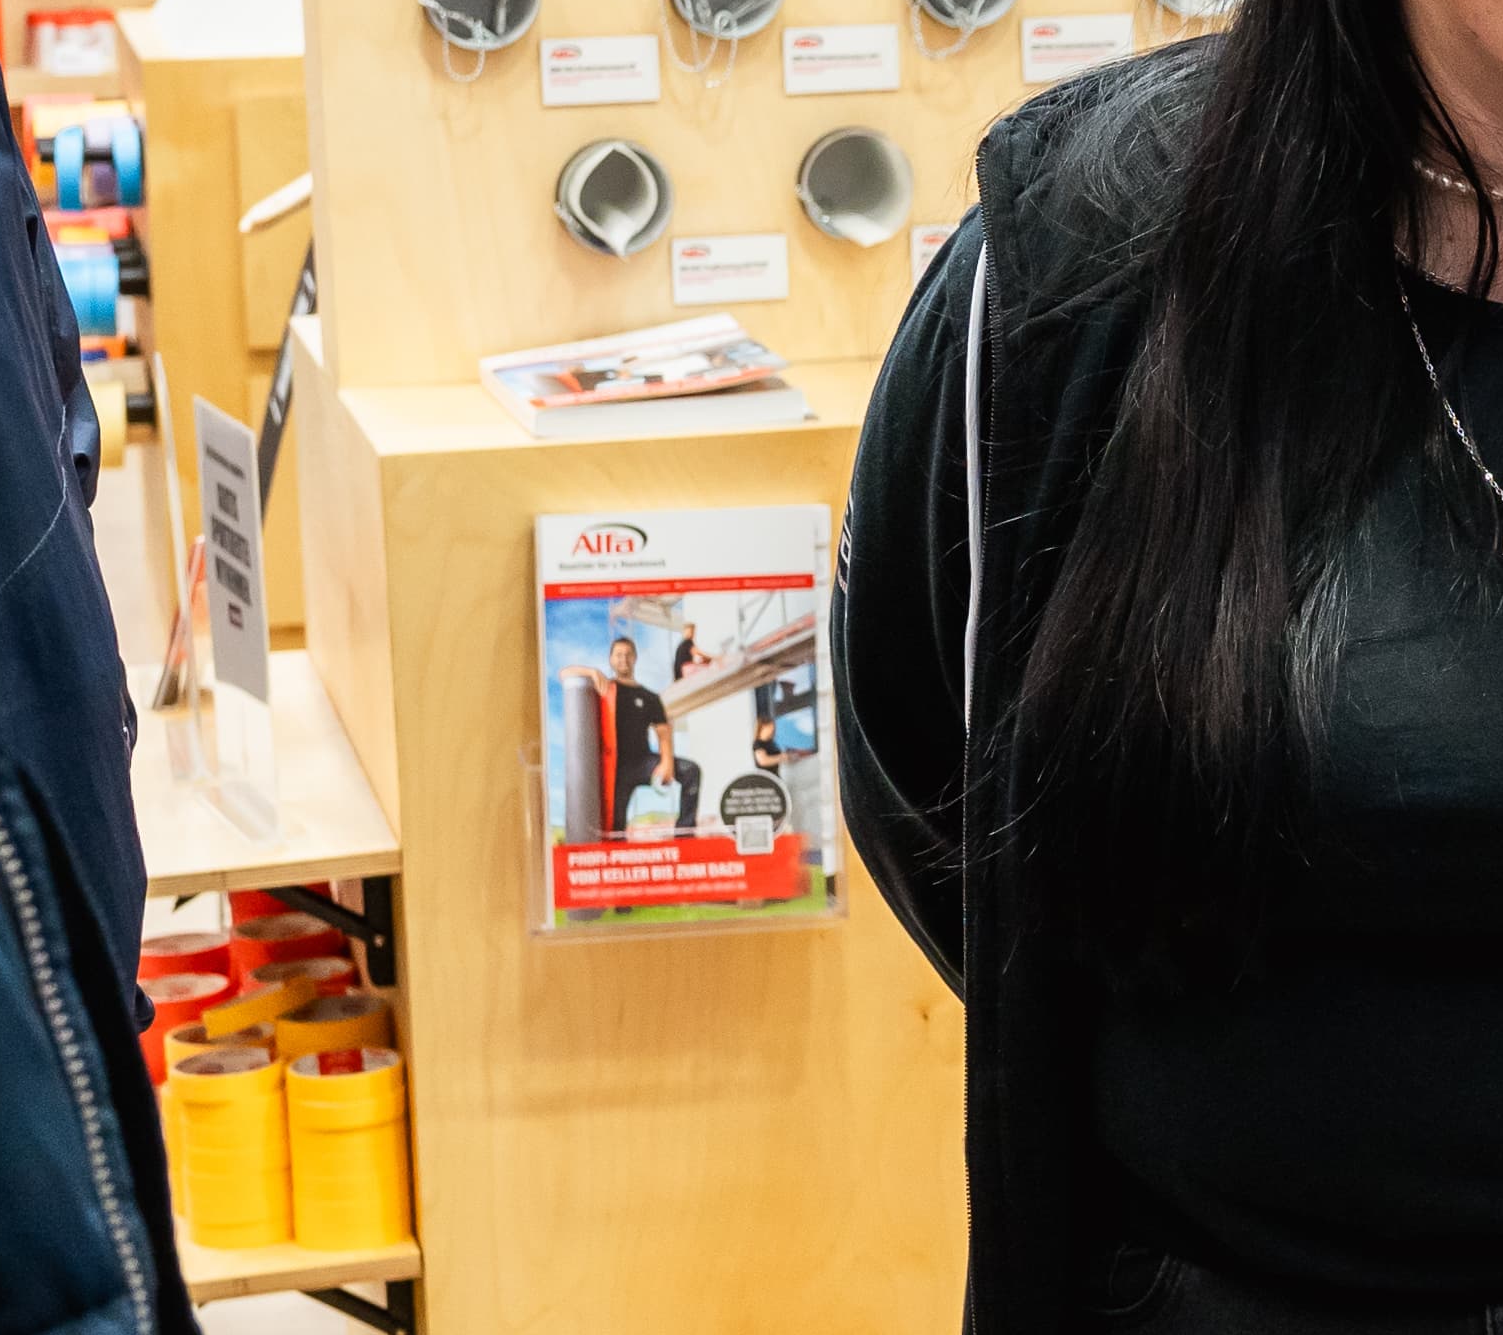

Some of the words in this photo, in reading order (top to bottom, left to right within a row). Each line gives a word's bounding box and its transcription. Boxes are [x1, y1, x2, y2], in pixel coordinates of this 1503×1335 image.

[572, 531, 636, 556] Alfa
[568, 868, 600, 886] VOM
[602, 865, 650, 883] KELLER
[676, 862, 707, 880] ZUM
[708, 861, 746, 878] DACH
